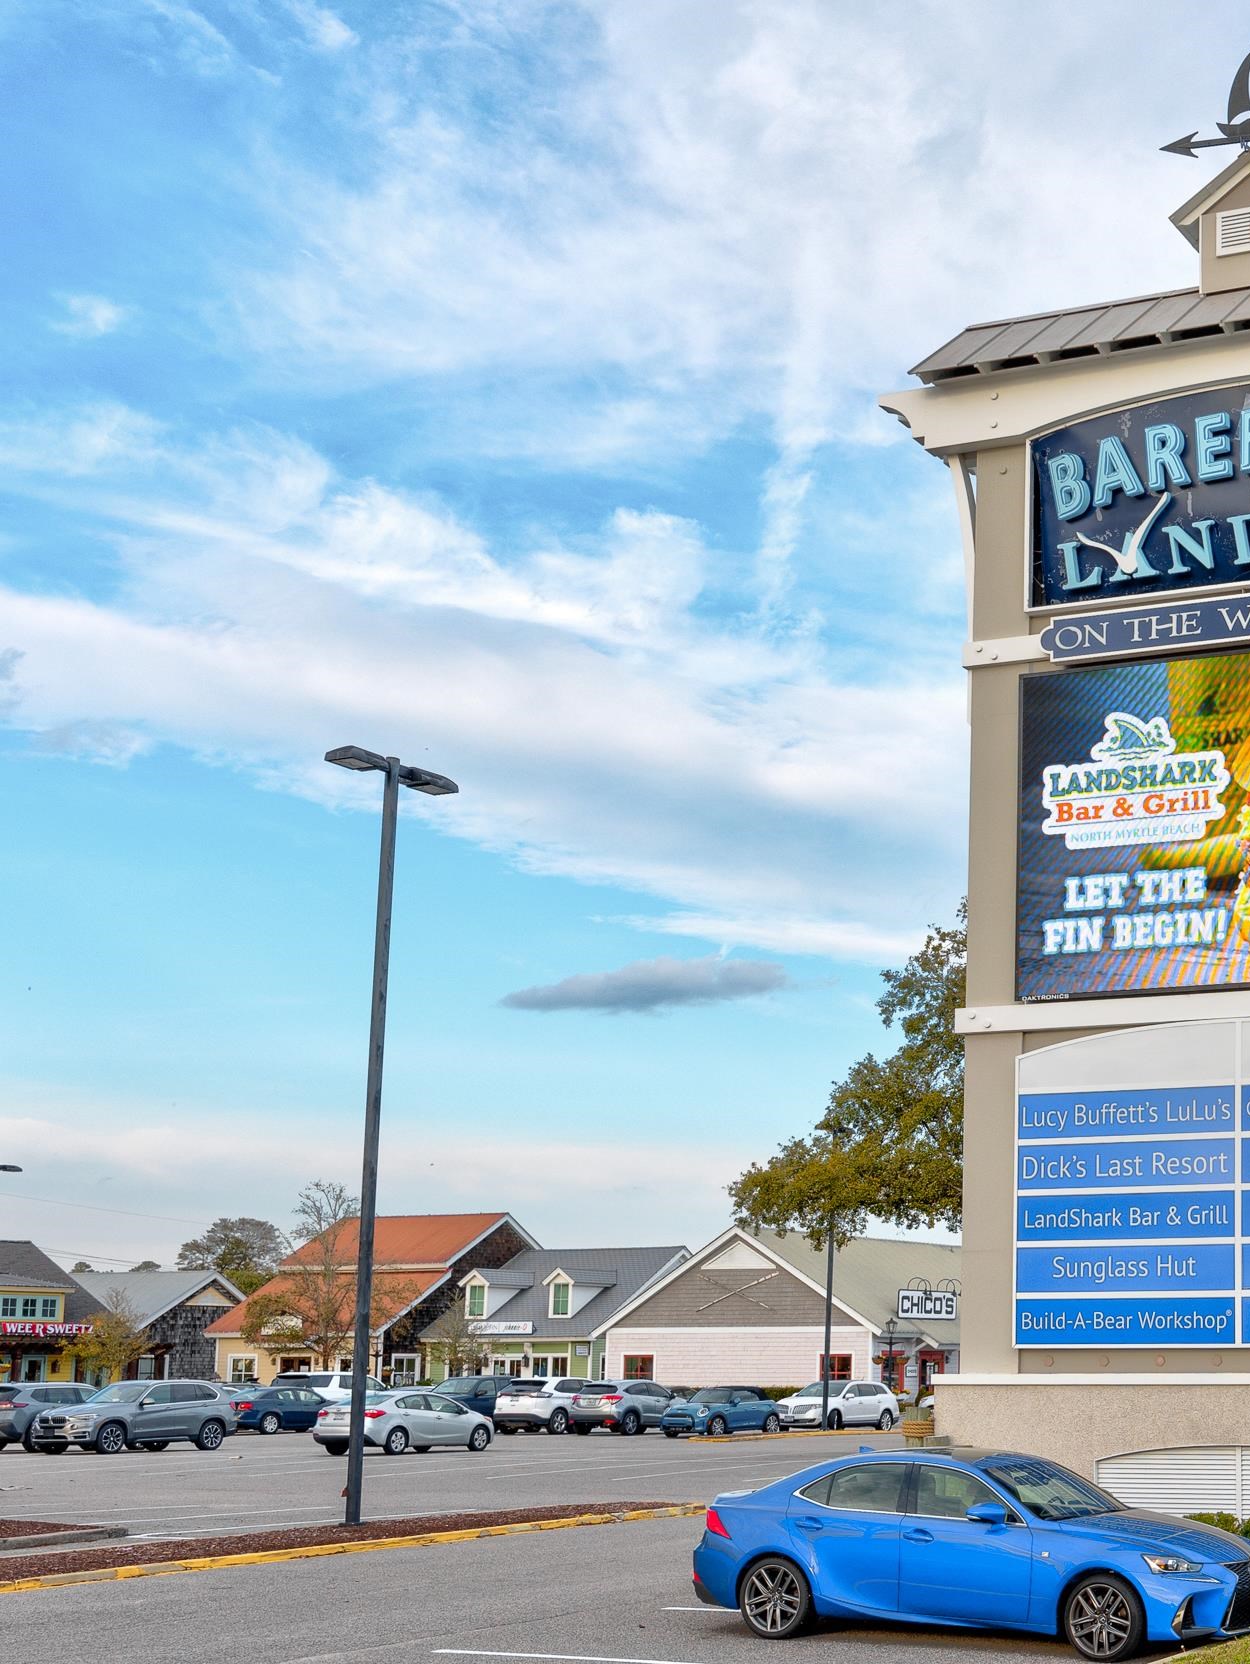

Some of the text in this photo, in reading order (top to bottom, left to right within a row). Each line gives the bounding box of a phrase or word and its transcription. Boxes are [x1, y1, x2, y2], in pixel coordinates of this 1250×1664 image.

[1055, 622, 1107, 651] ON
[1123, 611, 1202, 643] THE
[1049, 759, 1218, 797] LANDSHARK
[1055, 790, 1211, 823] Bar & Grill
[1071, 823, 1200, 843] NORTH MYRTLE BEACH
[1064, 866, 1208, 911] LET THE
[1042, 907, 1228, 954] FIN BEGIN!
[1021, 993, 1069, 1001] DAKTRONICS
[1022, 1098, 1231, 1132] Lucy Buffett's LuLu's
[1022, 1151, 1229, 1179] Dick's Last Resort
[1024, 1205, 1229, 1229] LandShark Bar & Grill
[1052, 1255, 1196, 1283] Sunglass Hut
[901, 1294, 954, 1315] CHICO'S
[6, 1323, 33, 1333] WEE
[35, 1323, 44, 1336] R
[1021, 1311, 1133, 1330] Build-A-Bear
